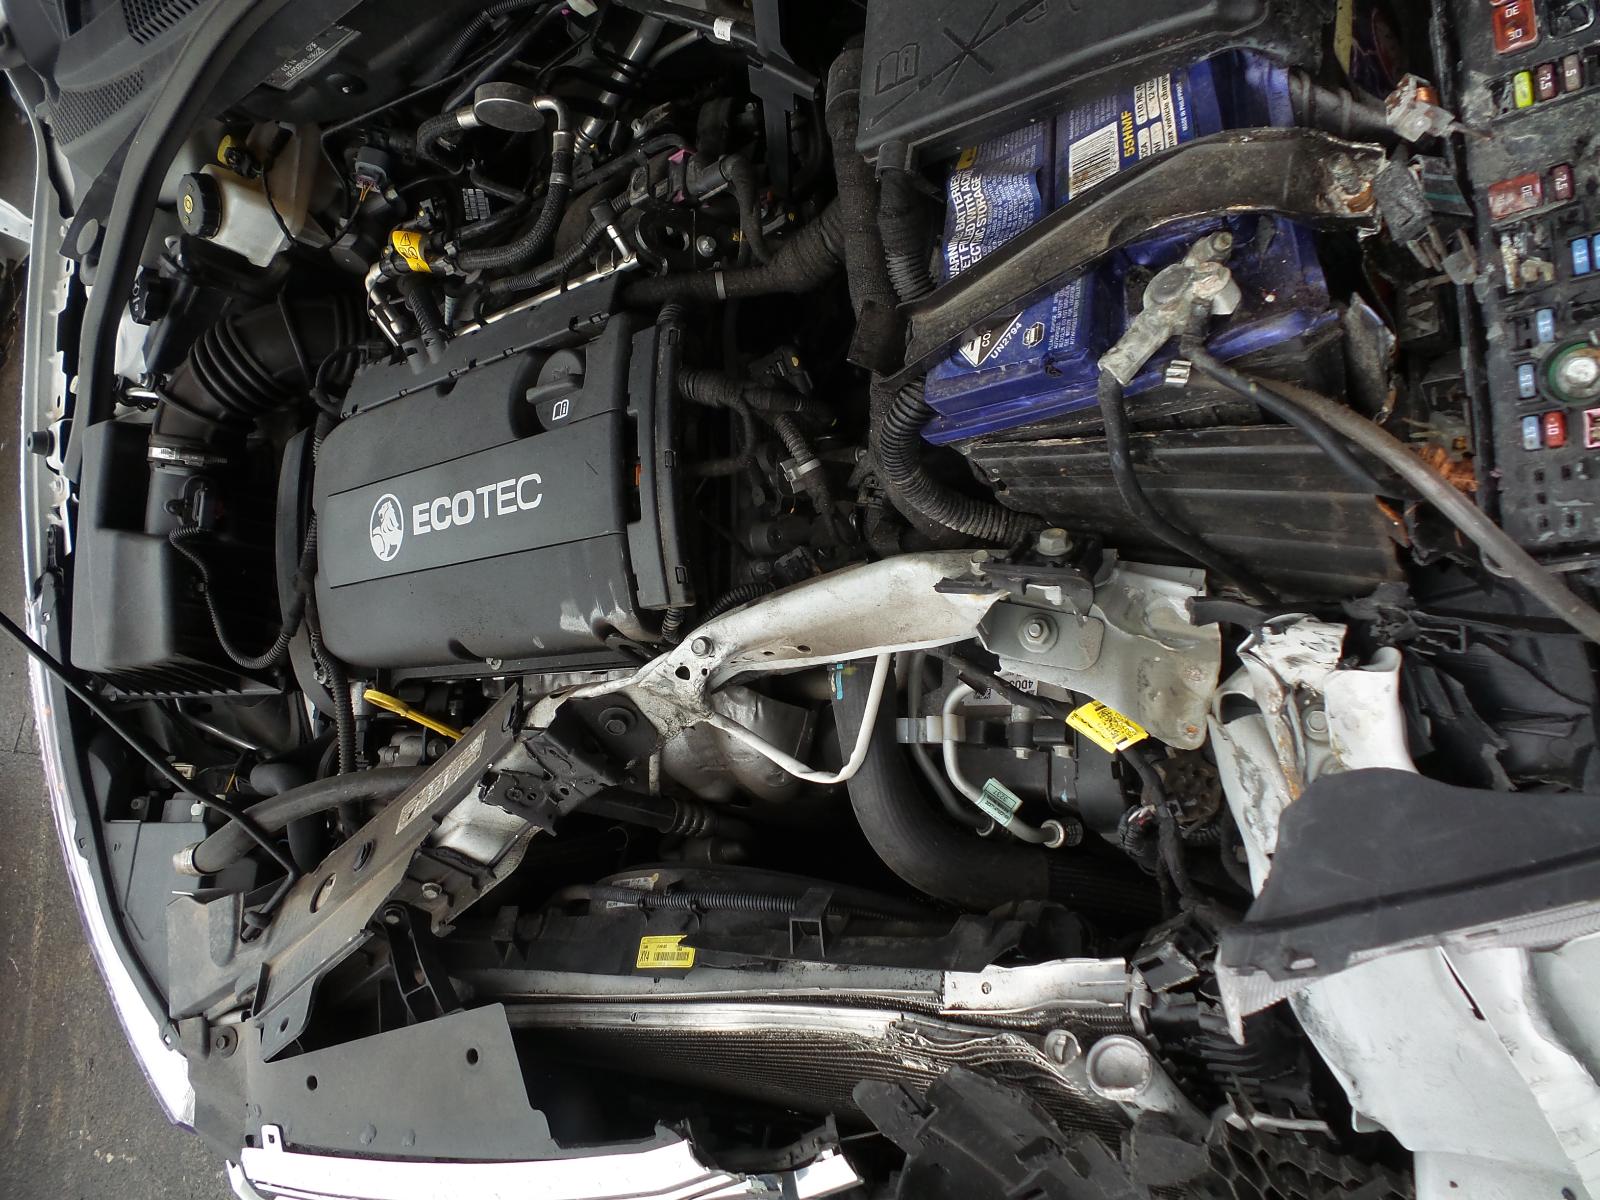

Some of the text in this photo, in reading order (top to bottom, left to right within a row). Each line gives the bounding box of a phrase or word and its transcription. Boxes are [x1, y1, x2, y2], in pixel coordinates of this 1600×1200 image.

[1508, 28, 1523, 41] 30
[1565, 68, 1577, 77] 5
[1162, 102, 1173, 130] vehicle
[1121, 111, 1136, 157] 55HMF
[963, 193, 978, 223] WITH
[971, 174, 988, 228] STORAGE
[959, 254, 971, 272] ET
[990, 321, 1023, 360] UN2794
[412, 473, 543, 536] ECOTEC
